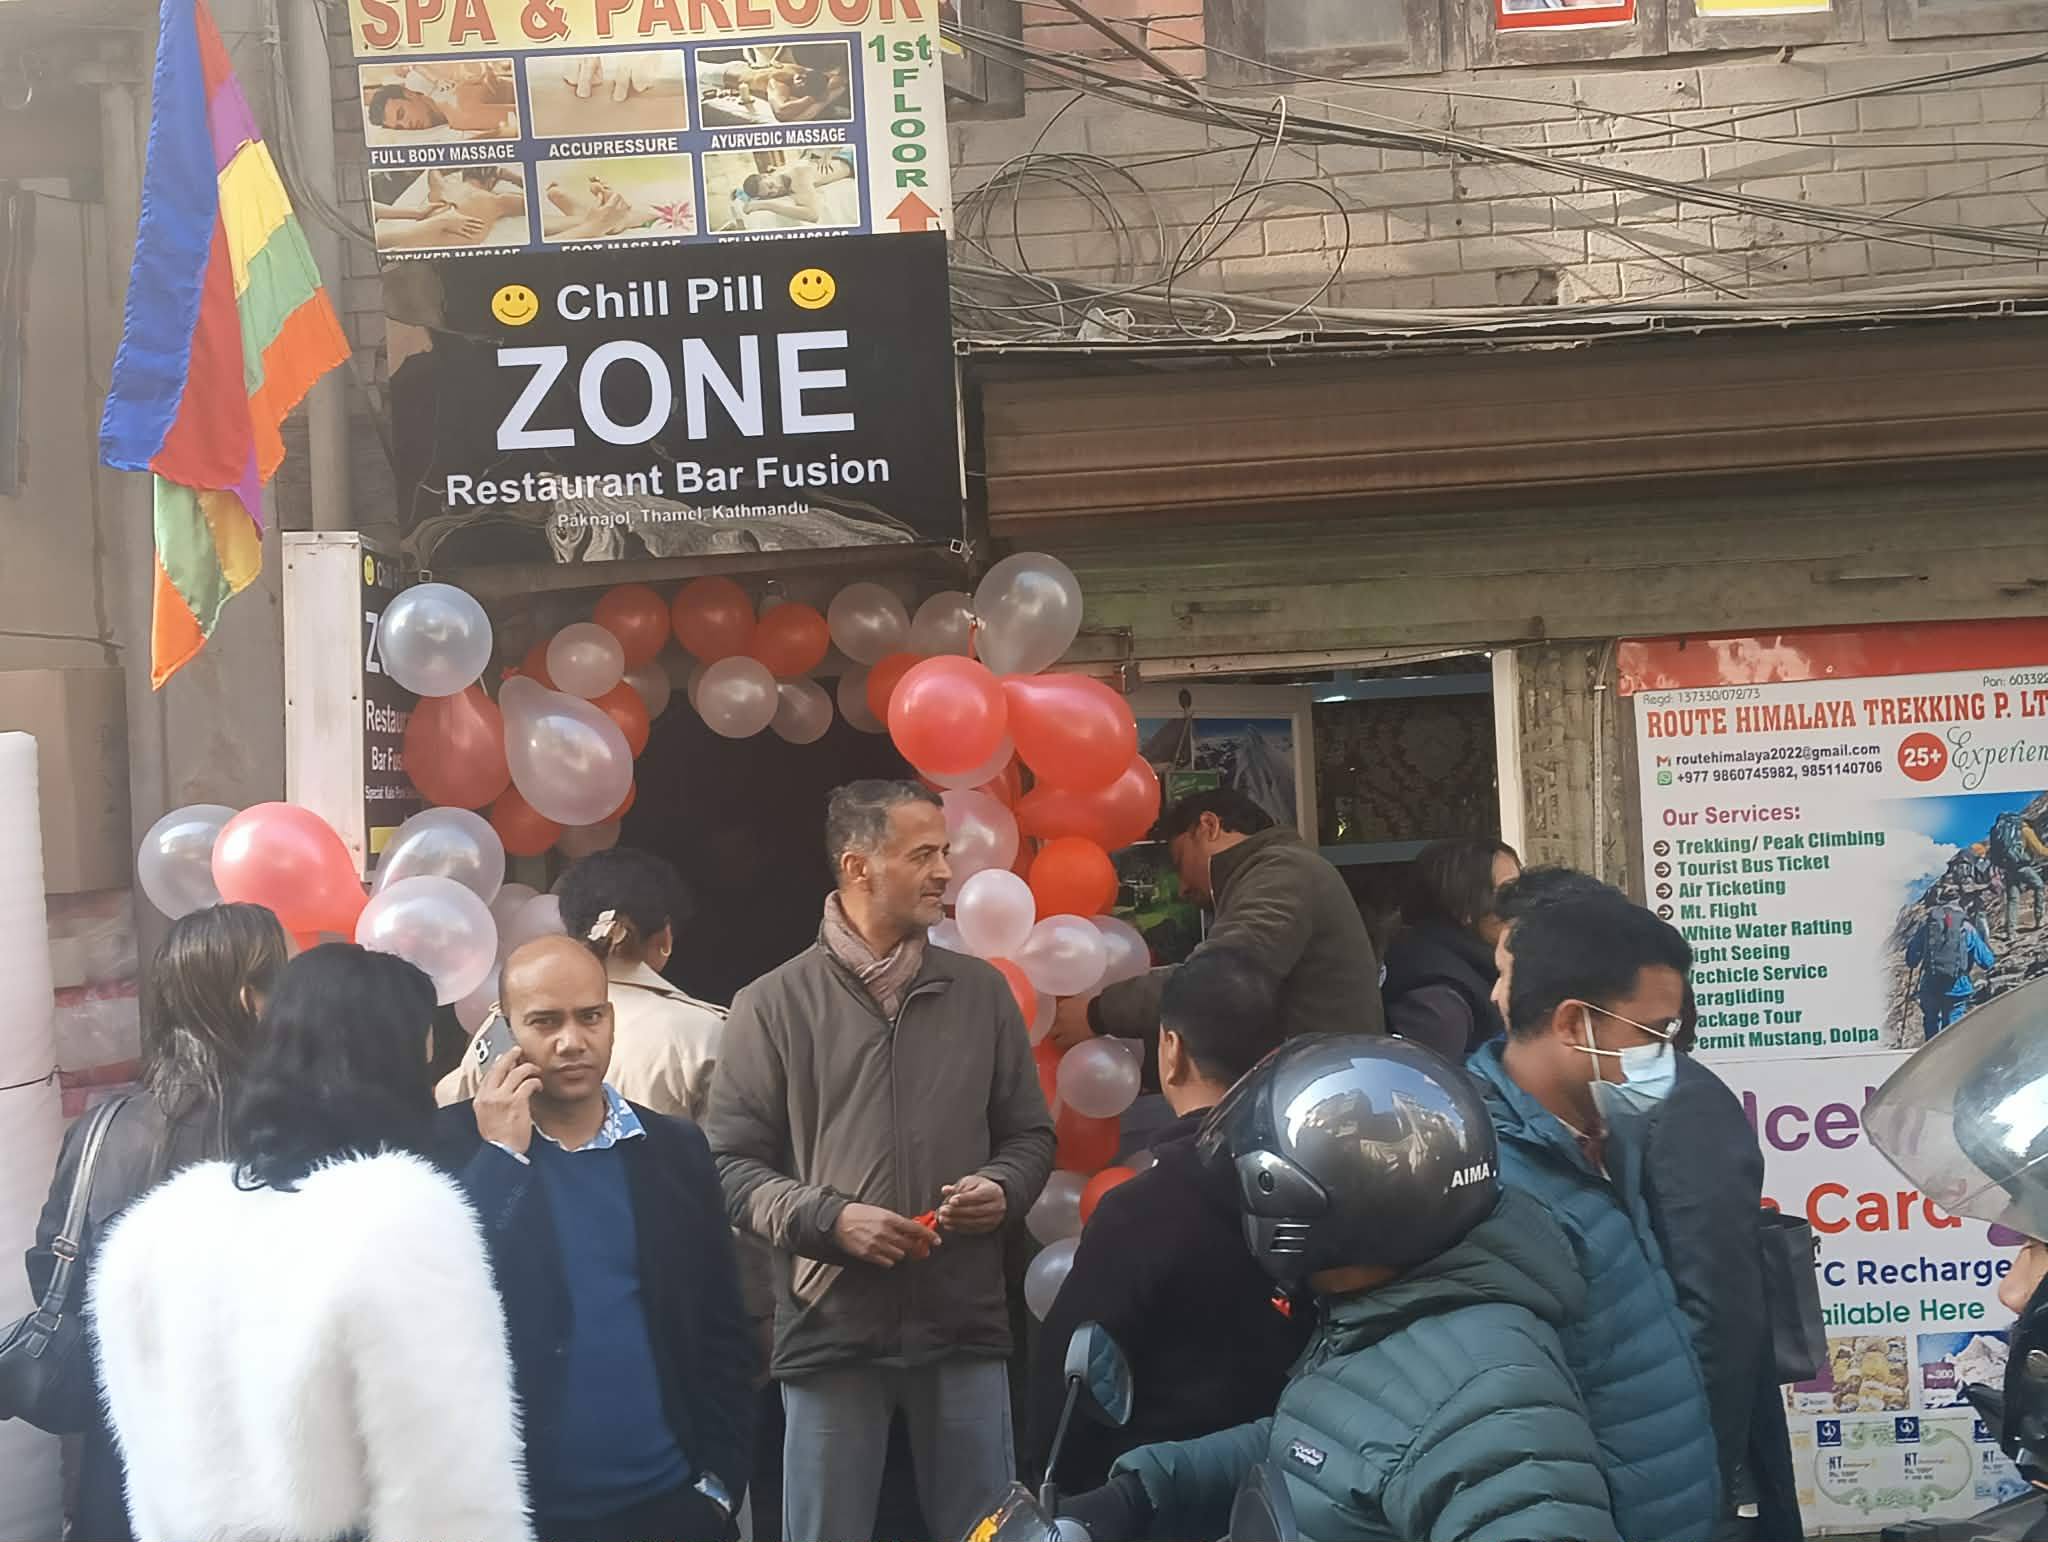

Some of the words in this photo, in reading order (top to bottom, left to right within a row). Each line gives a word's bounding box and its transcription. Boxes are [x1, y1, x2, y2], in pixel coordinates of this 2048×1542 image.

[868, 34, 932, 62] 1st
[711, 131, 783, 149] AYURVEDIC
[786, 127, 846, 144] MASSAGE
[890, 68, 928, 188] FLOOR
[371, 150, 405, 164] FULL
[409, 147, 445, 162] BODY
[449, 144, 515, 160] MASSAGE
[549, 136, 679, 158] ACCUPRESSURE
[556, 280, 669, 321] Chill
[687, 275, 763, 314] Pill
[496, 329, 855, 451] ZONE
[446, 465, 664, 507] Restaurant
[675, 456, 744, 494] Bar
[756, 453, 890, 490] Fusion
[712, 501, 809, 519] Kathmandu
[1646, 707, 1727, 738] ROUTE
[1735, 700, 1857, 734] HIMALAYA
[1863, 692, 1985, 726] TREKKING
[1993, 692, 2012, 719] P.
[371, 745, 387, 771] Bar
[1676, 743, 1881, 766] routehimalaya2022@gmail.com
[1903, 747, 1942, 767] 25+
[1677, 769, 1709, 784] +977
[1713, 766, 1798, 782] 9860745982,
[1801, 761, 1882, 777] 9851140706
[1662, 808, 1698, 827] Our
[1705, 804, 1800, 824] Services:
[1676, 836, 1758, 855] Trekking/
[1763, 833, 1804, 850] Peak
[1808, 830, 1886, 849] Climbing
[1678, 859, 1738, 877] Tourist
[1741, 858, 1773, 874] Bus
[1776, 855, 1830, 872] Ticket
[1679, 882, 1702, 898] Air
[1706, 879, 1786, 898] Ticketing
[1680, 904, 1706, 920] Mt.
[1710, 902, 1758, 920] Flight
[1681, 925, 1732, 941] White
[1736, 923, 1787, 939] Water
[1791, 919, 1853, 937] Rafting
[1694, 946, 1728, 964] ight
[1731, 943, 1790, 961] Seeing
[1762, 963, 1828, 981] Service
[1696, 988, 1785, 1007] aragliding
[1697, 1011, 1760, 1029] ackage
[1764, 1009, 1803, 1025] Tour
[1749, 1029, 1827, 1048] Mustang,
[1830, 1026, 1879, 1044] Dolpa
[1857, 1256, 2013, 1287] Recharge
[1919, 1298, 1985, 1322] Here
